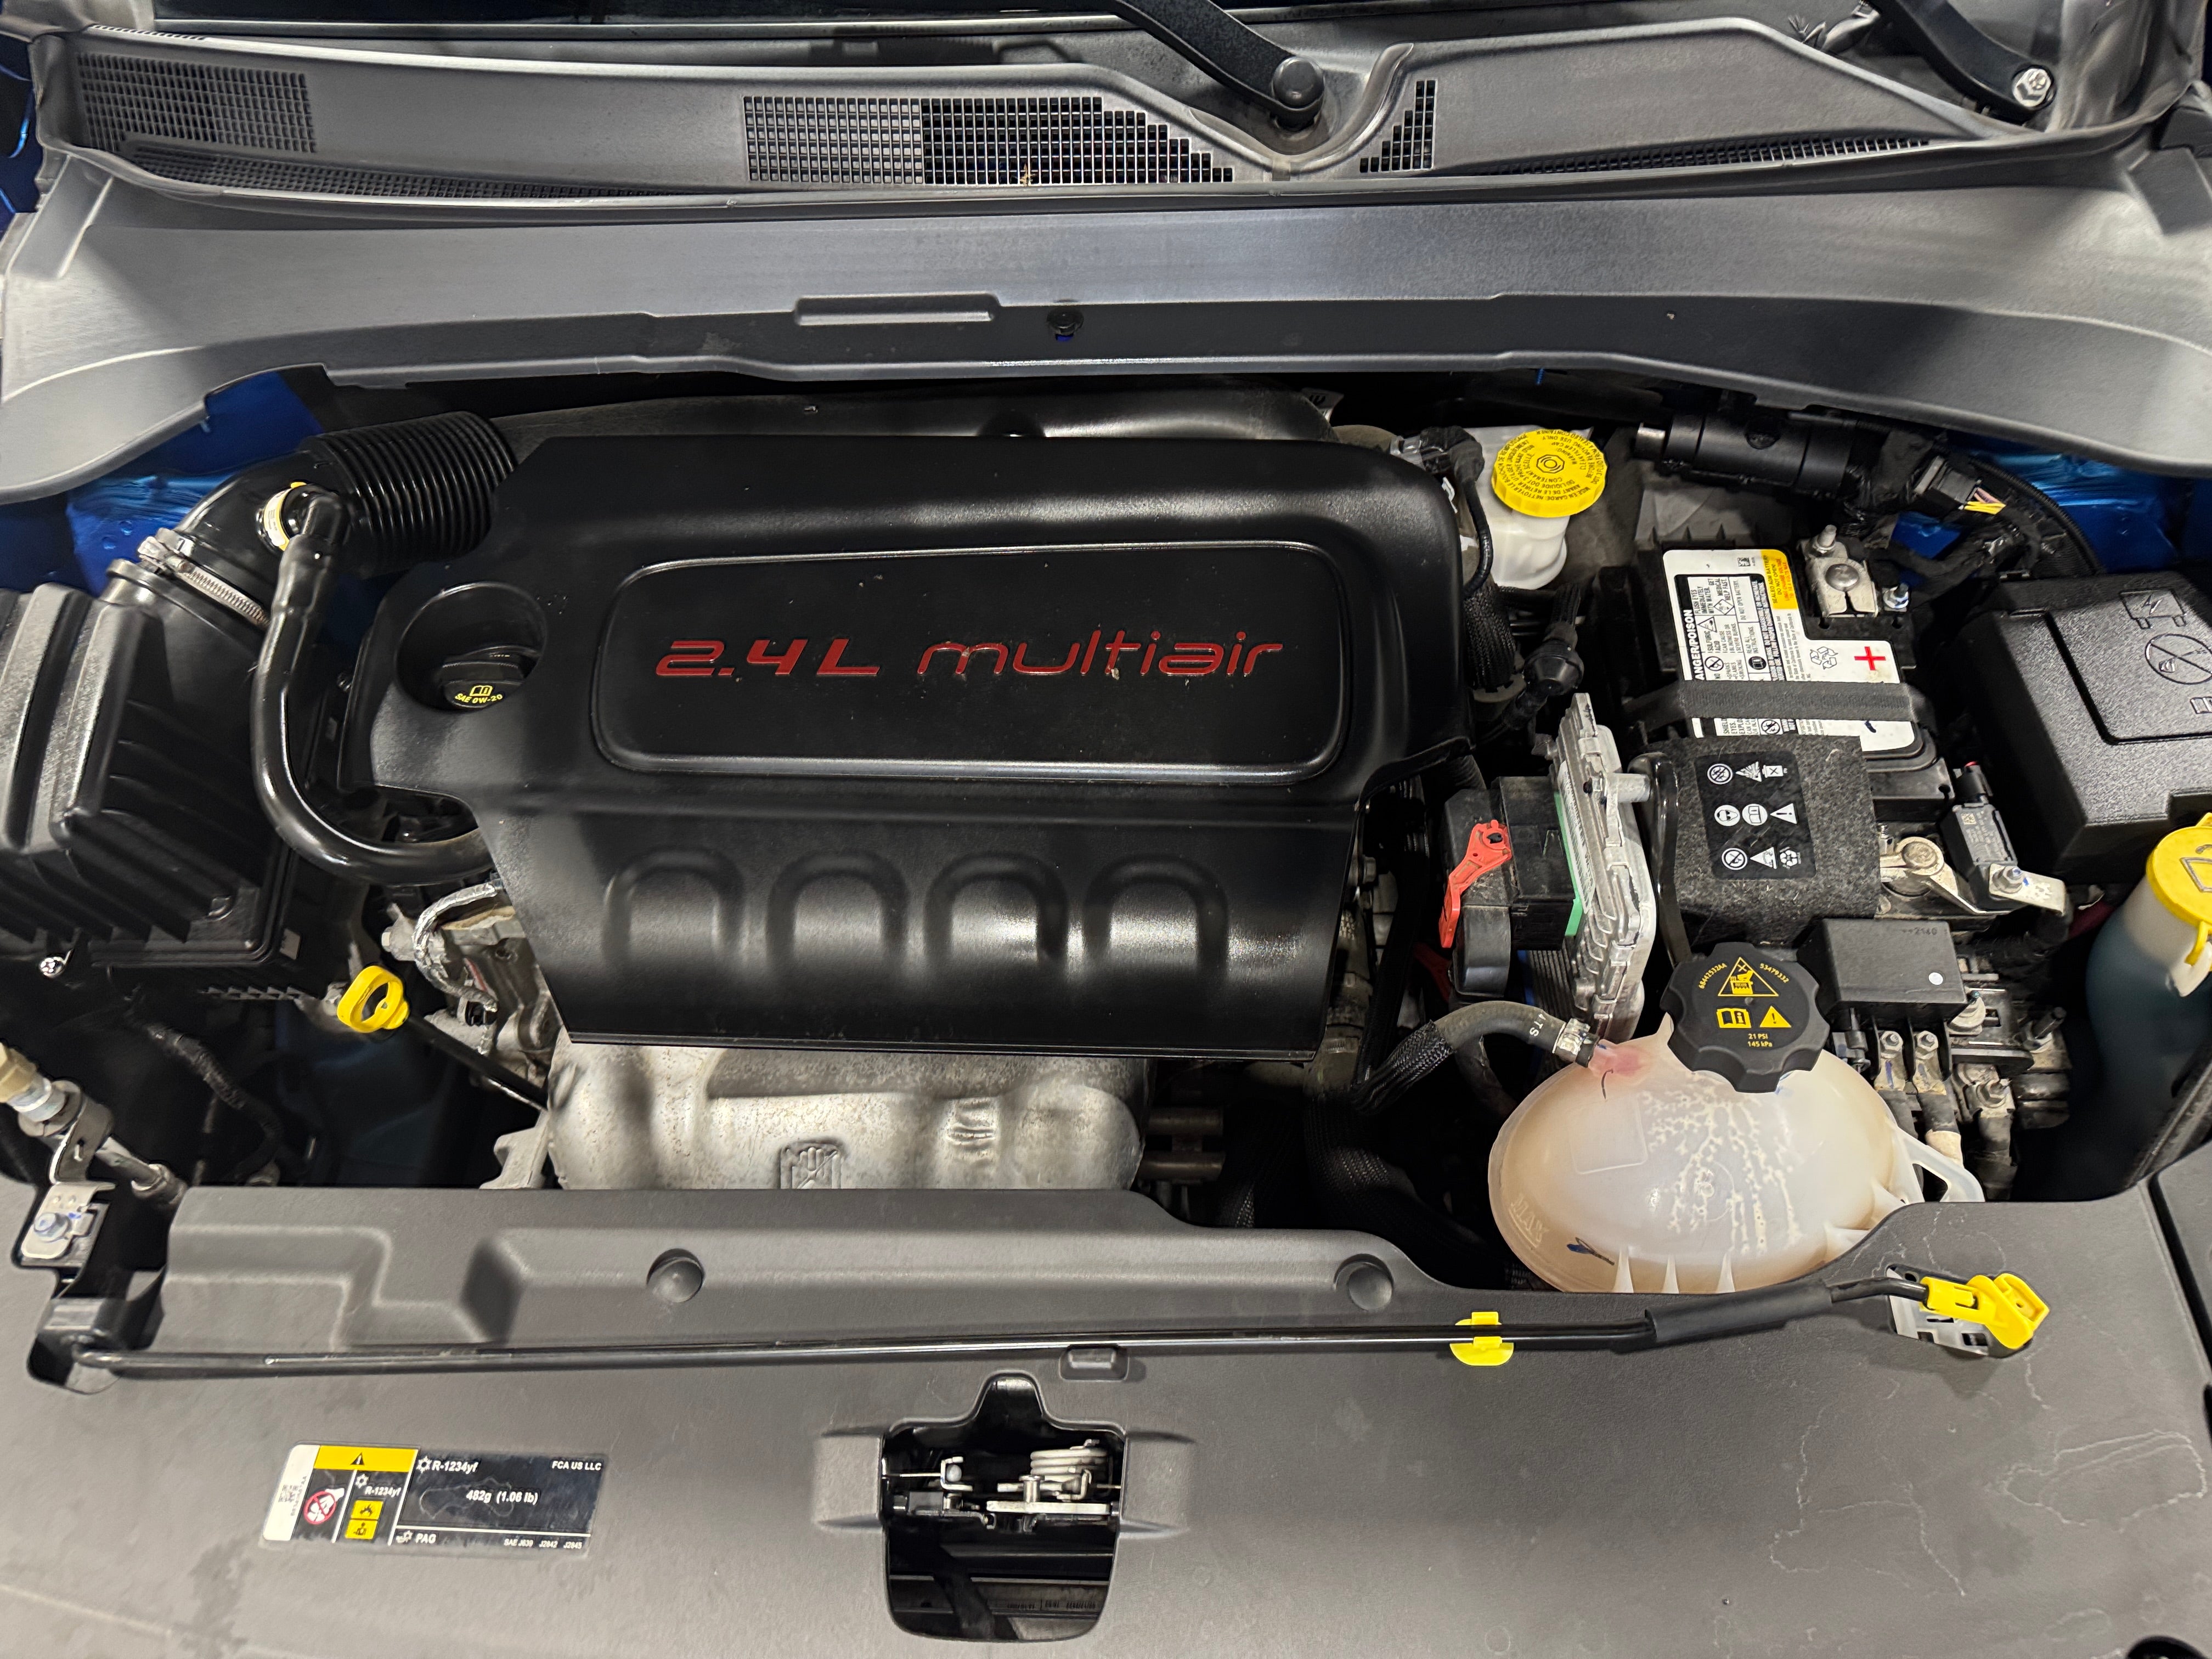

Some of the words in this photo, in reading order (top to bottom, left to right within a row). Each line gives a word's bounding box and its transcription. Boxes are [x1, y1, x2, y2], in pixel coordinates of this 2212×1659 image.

[1516, 481, 1542, 494] RETIRER
[1526, 478, 1541, 487] DOT
[1562, 483, 1582, 494] AVANT
[1511, 486, 1544, 500] NETTOYER
[1714, 578, 1723, 596] MEDICAL
[1690, 589, 1699, 600] EYES
[1697, 586, 1707, 614] IMMEDIATELY
[1683, 609, 1705, 680] ANGER/POISON
[917, 630, 1283, 677] multiair
[455, 693, 472, 703] SAE
[472, 693, 503, 704] 0W-20
[432, 1460, 479, 1474] R-1234yf
[551, 1460, 569, 1469] FCA
[571, 1462, 583, 1470] US
[585, 1462, 602, 1471] LLC
[364, 1486, 402, 1497] R-1234yf
[466, 1489, 492, 1504] 482g
[524, 1492, 538, 1505] lb)
[415, 1533, 437, 1544] PAG
